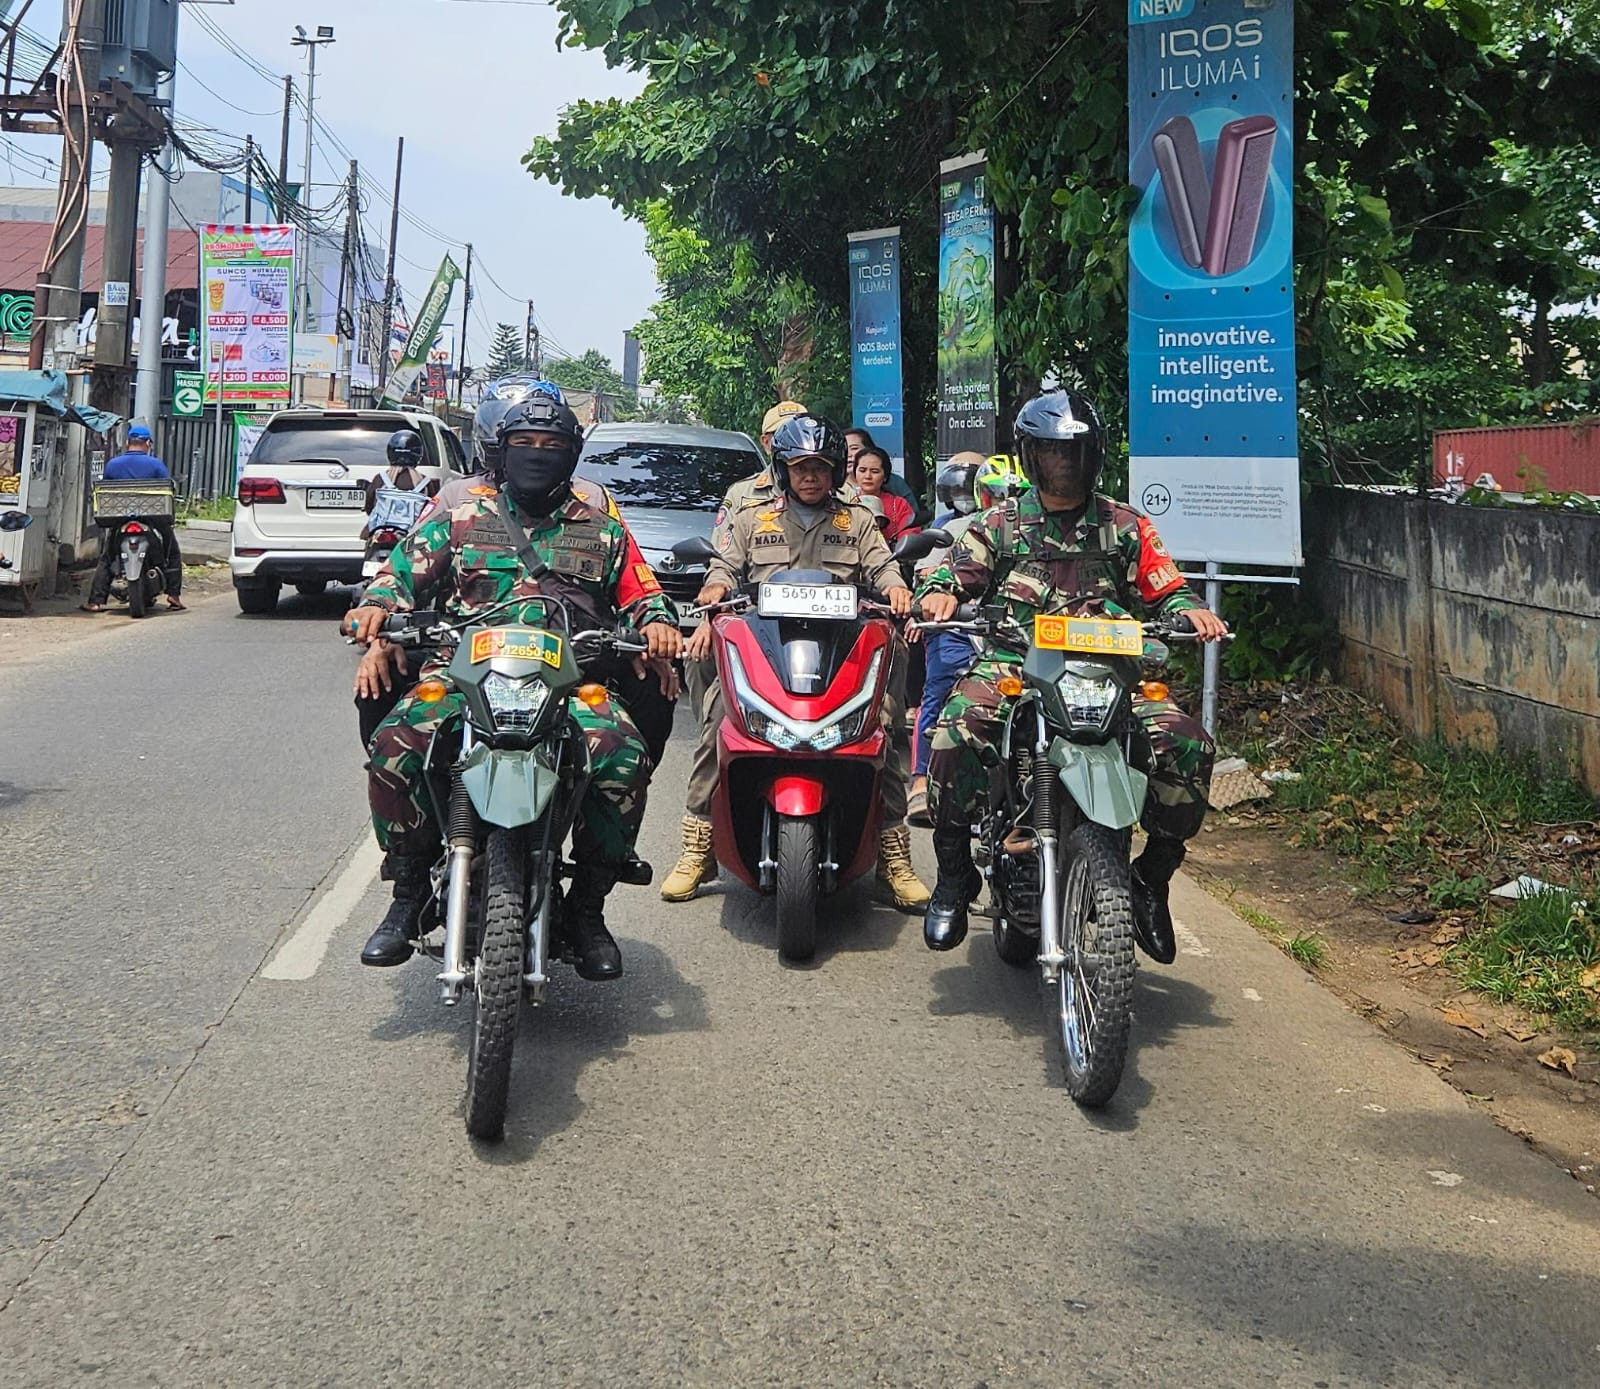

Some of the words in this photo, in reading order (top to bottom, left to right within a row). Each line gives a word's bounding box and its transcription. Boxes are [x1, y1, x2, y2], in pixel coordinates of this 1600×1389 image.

[1140, 0, 1182, 17] NEW
[1160, 18, 1263, 59] IQOS
[1160, 57, 1248, 91] ILUMA
[1253, 54, 1261, 79] i
[943, 208, 964, 224] TEREA
[858, 263, 892, 280] IQOS
[1158, 324, 1276, 348] innovative.
[876, 340, 897, 352] Booth
[862, 355, 893, 366] terdekat
[1159, 354, 1276, 380] intelligent.
[945, 381, 963, 395] Fresh
[964, 380, 990, 397] garden
[1151, 383, 1284, 409] imaginative.
[938, 400, 956, 412] fruit
[957, 397, 974, 411] with
[948, 417, 960, 429] On
[960, 420, 966, 428] a
[310, 491, 315, 500] F
[320, 490, 343, 501] 1305
[1146, 493, 1169, 506] 21+
[823, 534, 841, 544] POL
[763, 586, 772, 599] B
[825, 588, 852, 601] KIJ
